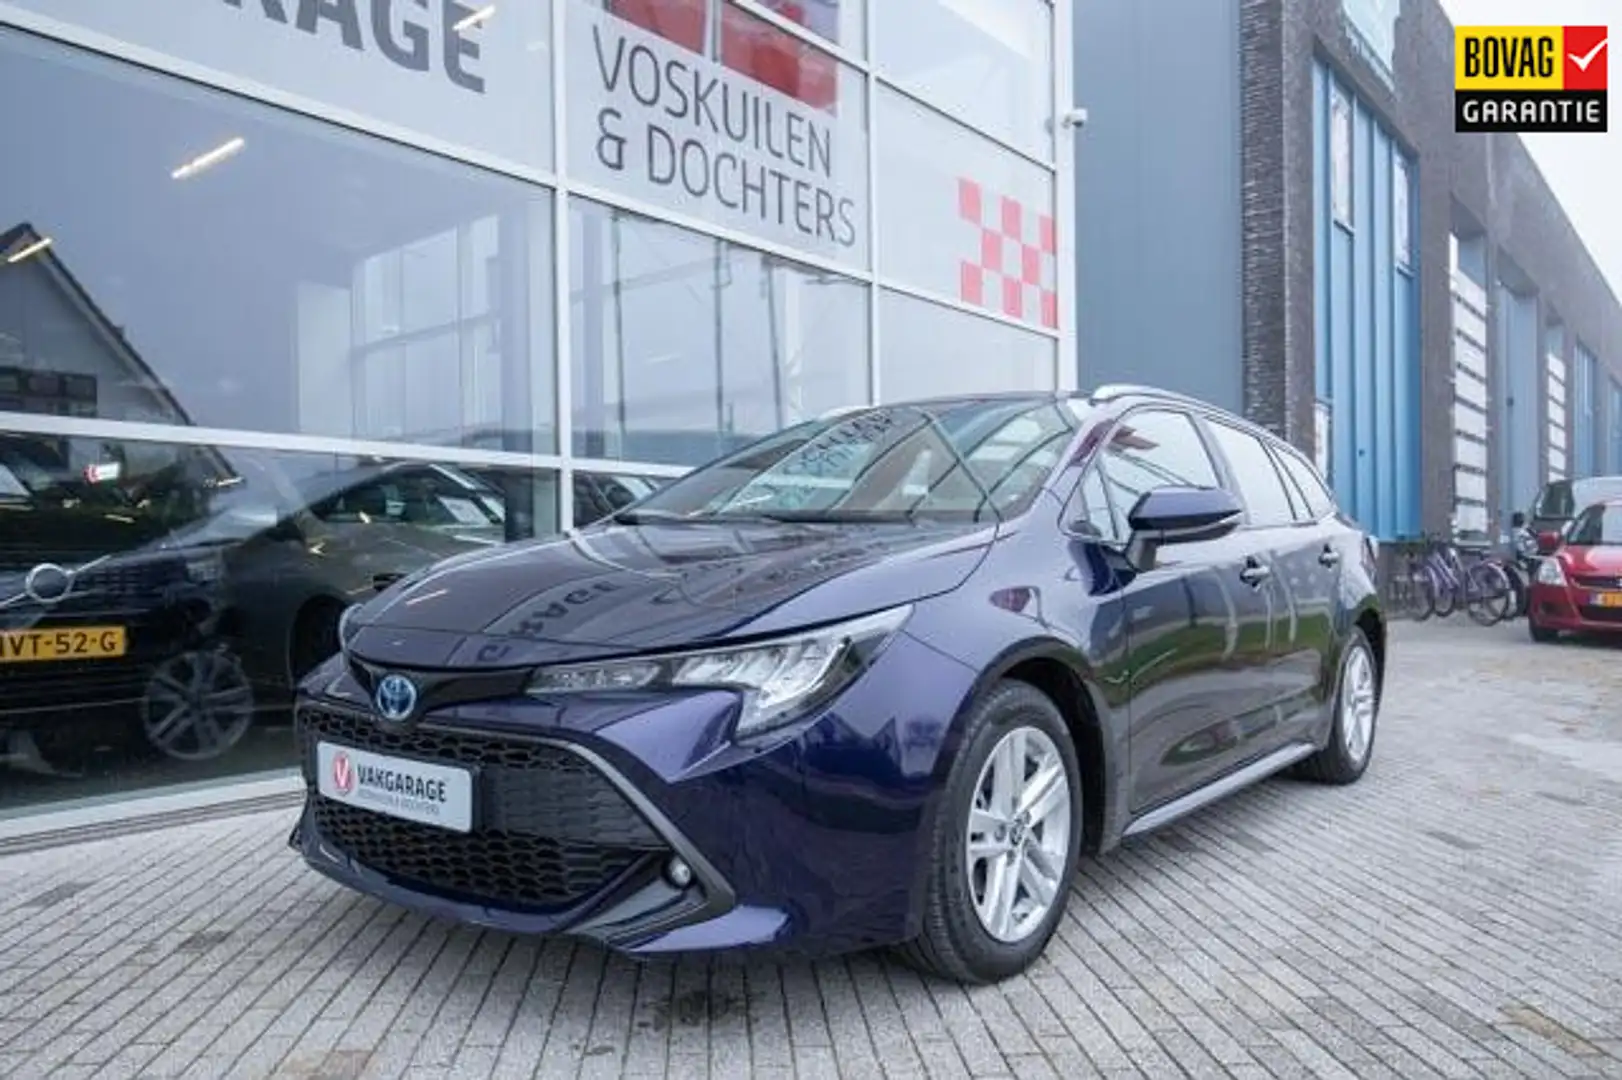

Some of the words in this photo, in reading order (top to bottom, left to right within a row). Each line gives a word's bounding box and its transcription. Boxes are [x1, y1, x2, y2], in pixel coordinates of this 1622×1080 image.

[222, 0, 485, 94] AGE
[593, 24, 830, 178] VOSKUILEN
[595, 107, 627, 171] &
[647, 122, 855, 247] DOCHTERS
[357, 763, 447, 802] VAKGARAGE
